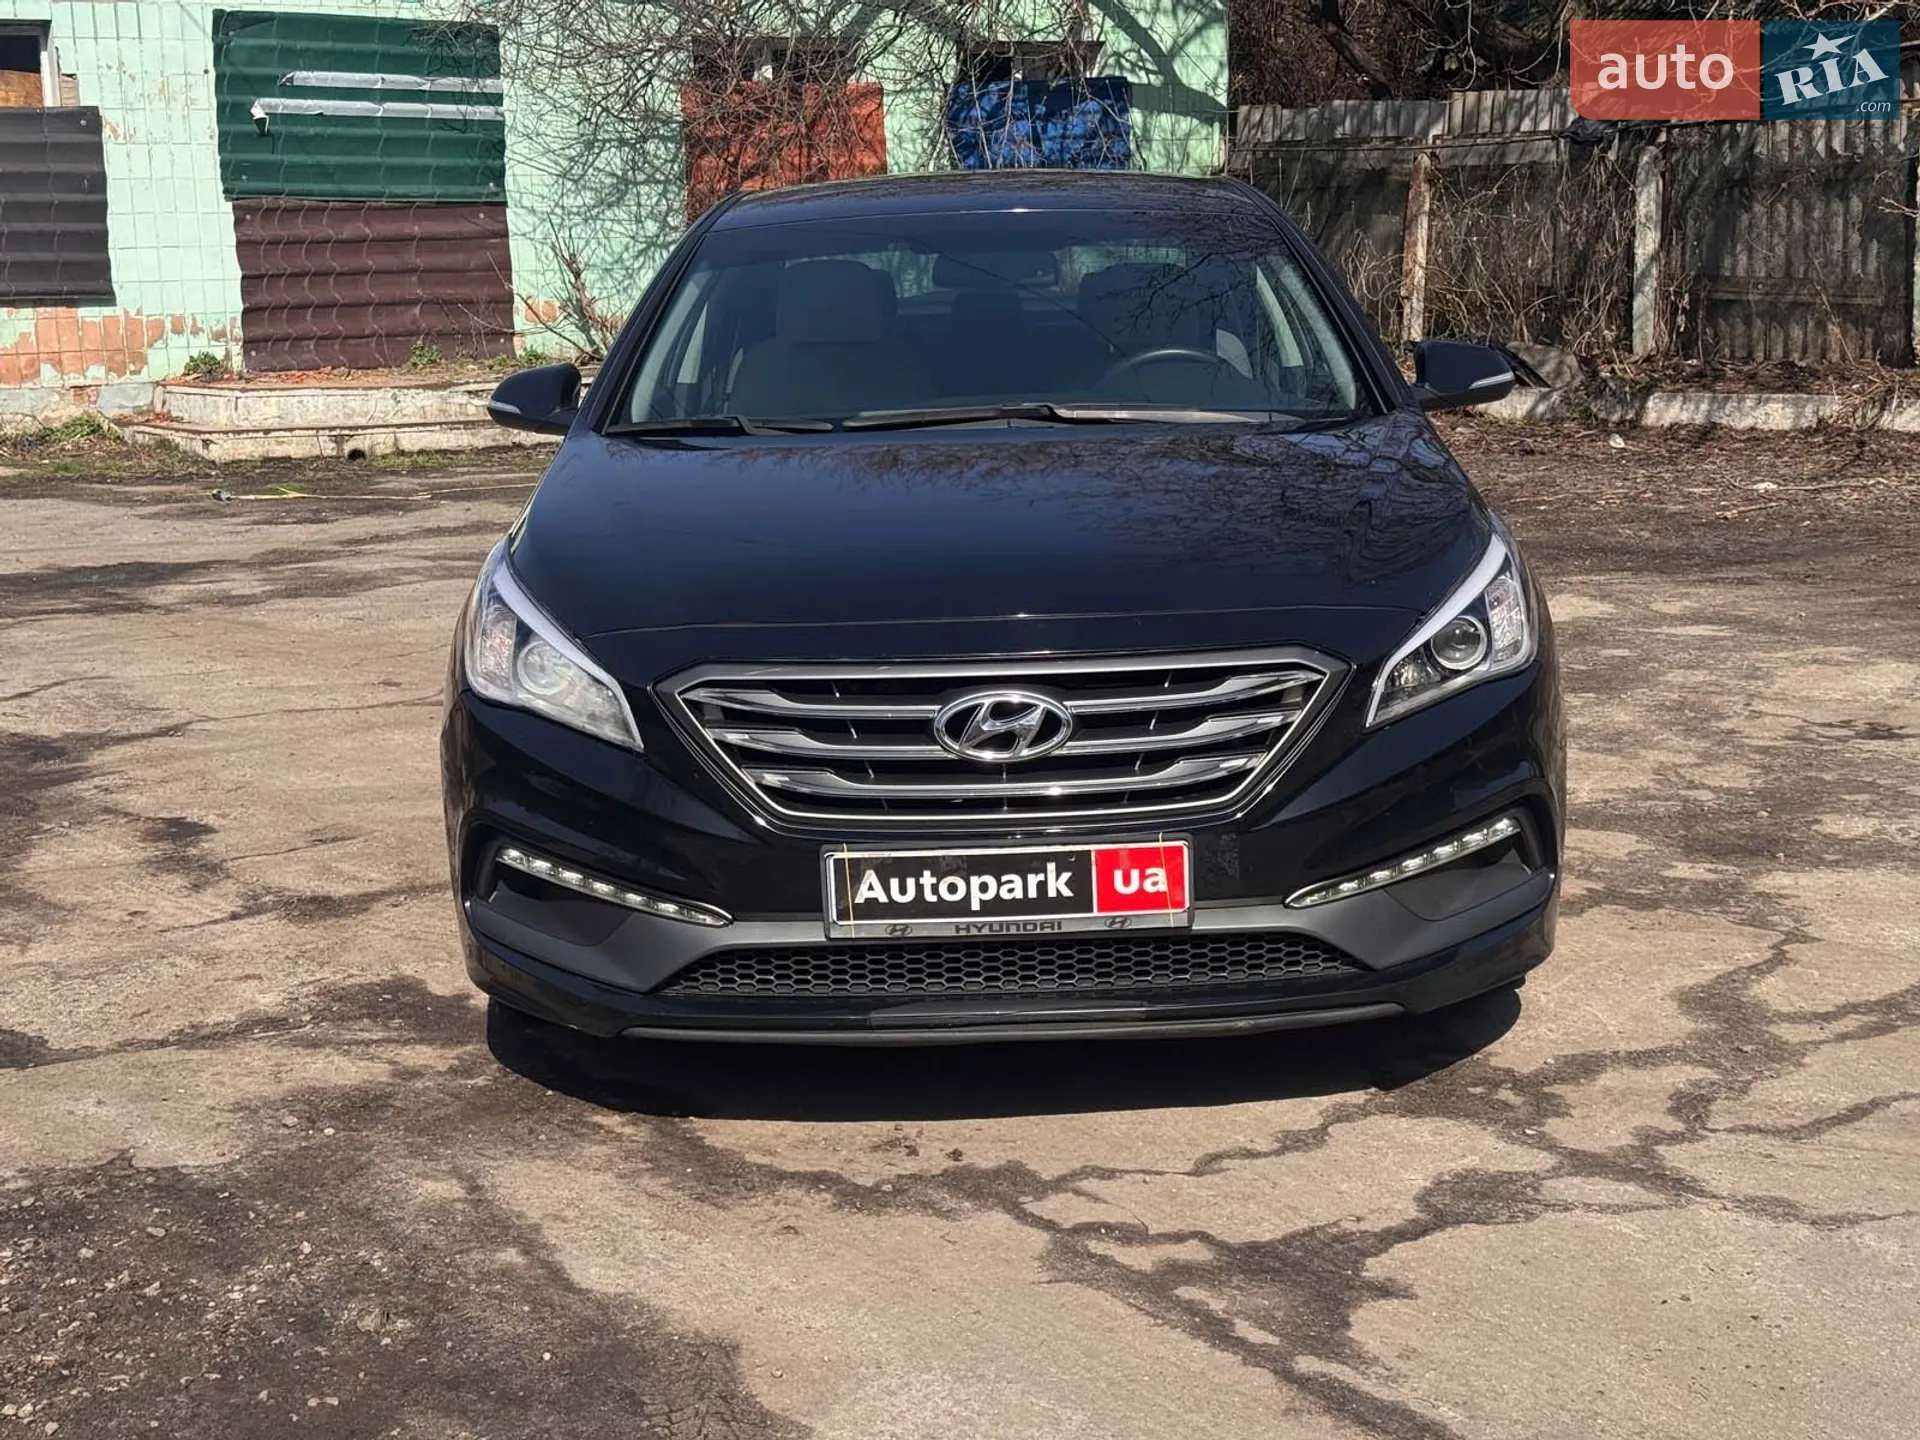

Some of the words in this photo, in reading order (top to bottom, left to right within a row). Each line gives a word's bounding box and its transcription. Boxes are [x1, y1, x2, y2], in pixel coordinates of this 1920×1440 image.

[854, 861, 1074, 910] Autopark
[1113, 866, 1168, 895] ua
[954, 920, 1063, 935] HYUNDAI
